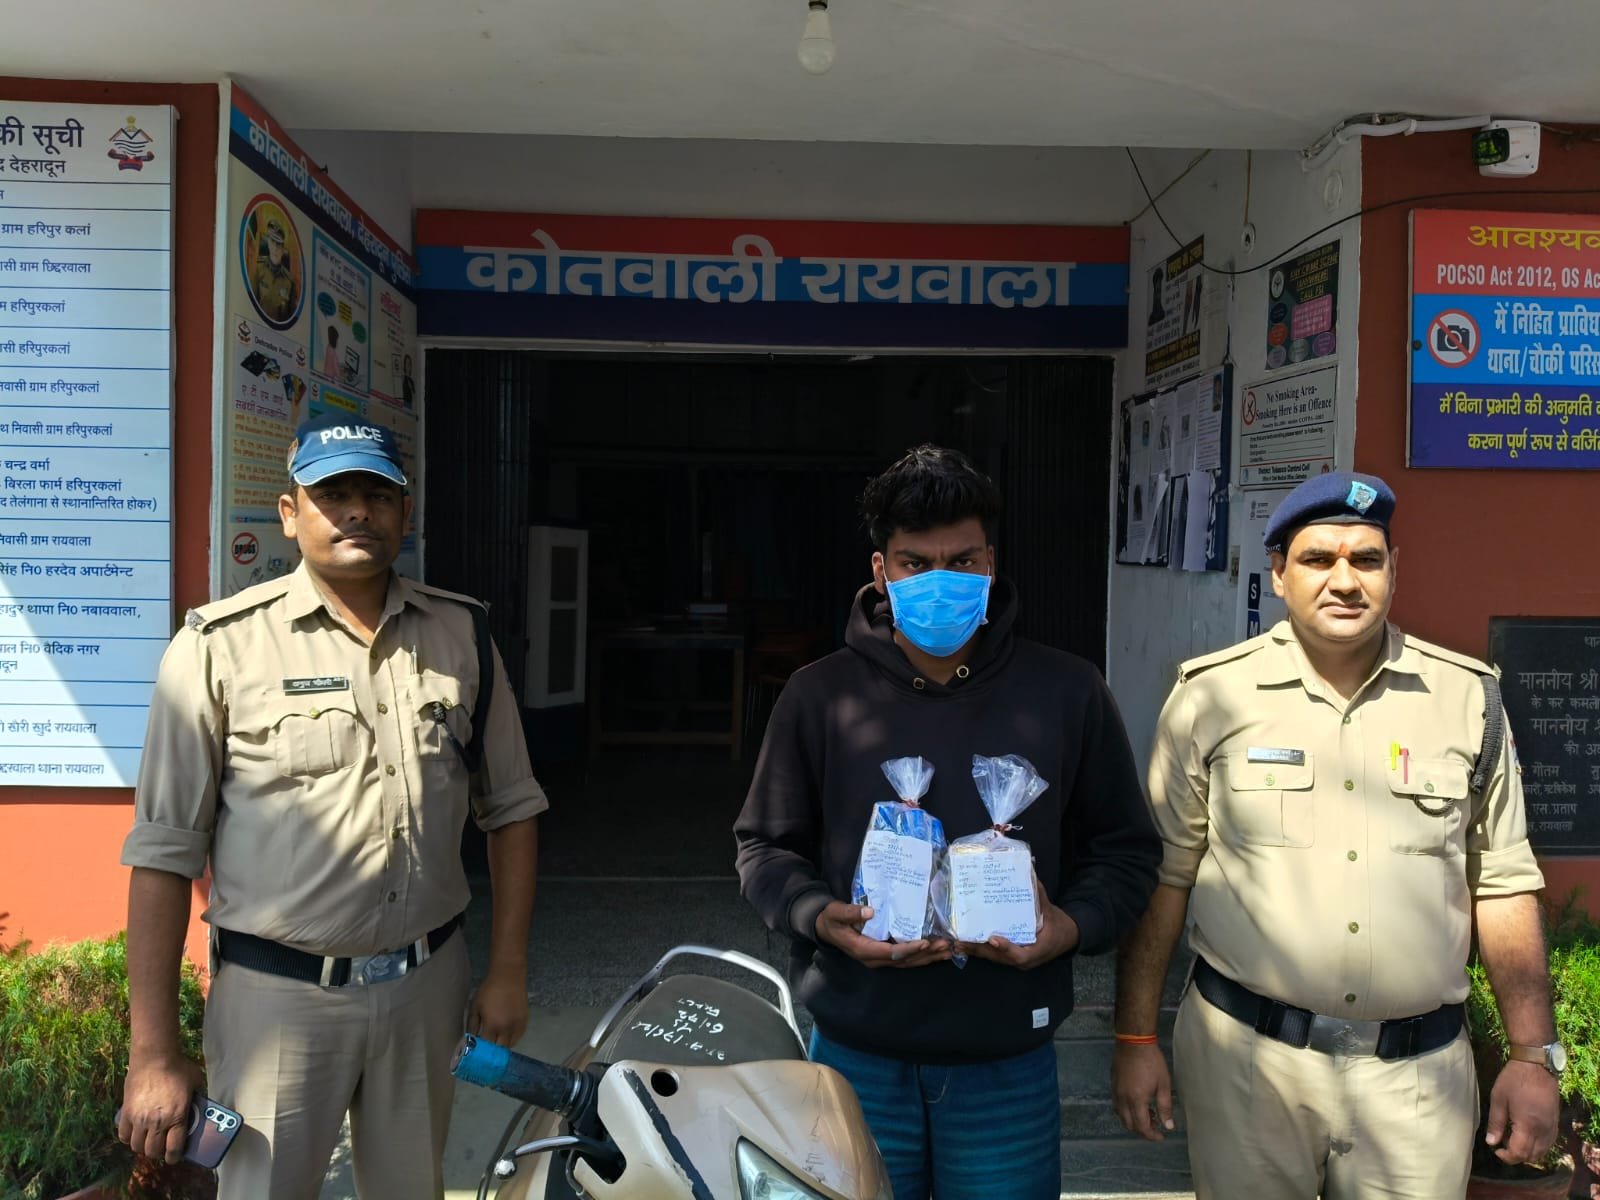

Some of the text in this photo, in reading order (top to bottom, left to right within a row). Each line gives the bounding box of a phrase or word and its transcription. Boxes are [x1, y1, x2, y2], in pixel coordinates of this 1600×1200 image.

[32, 118, 84, 155] सूची
[249, 118, 309, 194] कोतवाली
[9, 154, 67, 178] देहरादून
[1, 221, 91, 239] ग्राम हरिपुर कलां
[20, 262, 39, 273] ग्राम
[463, 229, 1076, 309] कोतवाली रायवाला
[1437, 264, 1600, 291] POCSO Act 2012, OS Ac
[10, 298, 66, 316] हरिपुरकलां
[1494, 302, 1509, 335] में
[1512, 302, 1553, 335] निहित
[19, 341, 70, 357] हरिपुरकलां
[1487, 342, 1564, 377] थाना/चौकी
[29, 382, 47, 393] ग्राम
[50, 379, 100, 396] हरिपुरकलां
[1265, 393, 1274, 404] No
[1275, 388, 1299, 402] Smoking
[1256, 407, 1278, 420] Smoking
[1279, 404, 1292, 417] Here
[1293, 403, 1298, 415] is
[1308, 398, 1332, 412] Offence
[1440, 391, 1453, 414] में
[1455, 391, 1482, 415] बिना
[1486, 392, 1521, 417] प्रभारी
[1524, 392, 1542, 416] की
[1545, 393, 1593, 425] अनुमति
[12, 420, 43, 435] निवासी
[46, 424, 63, 436] ग्राम
[66, 422, 112, 440] हरिपुरकलां
[320, 425, 384, 445] POLICE
[1468, 433, 1503, 450] करना
[1506, 427, 1528, 458] पूर्ण
[1530, 433, 1553, 450] रूप
[1556, 429, 1568, 451] से
[30, 457, 50, 471] वर्मा
[4, 476, 122, 494] बिरला फार्म हरिपुरकलां
[10, 494, 47, 508] तेलंगाना
[51, 496, 59, 509] से
[127, 497, 157, 512] होकर)
[31, 535, 49, 546] ग्राम
[52, 535, 91, 547] रायवाला
[45, 565, 76, 577] हरदेव
[1250, 583, 1257, 600] S
[27, 604, 54, 616] थापा
[77, 645, 100, 655] नगर
[1517, 668, 1599, 691] माननीय श्री
[1530, 694, 1542, 709] के
[54, 723, 97, 734] रायवाला
[1529, 713, 1589, 737] माननीय
[38, 763, 62, 775] थाना
[64, 764, 105, 775] रायवाला
